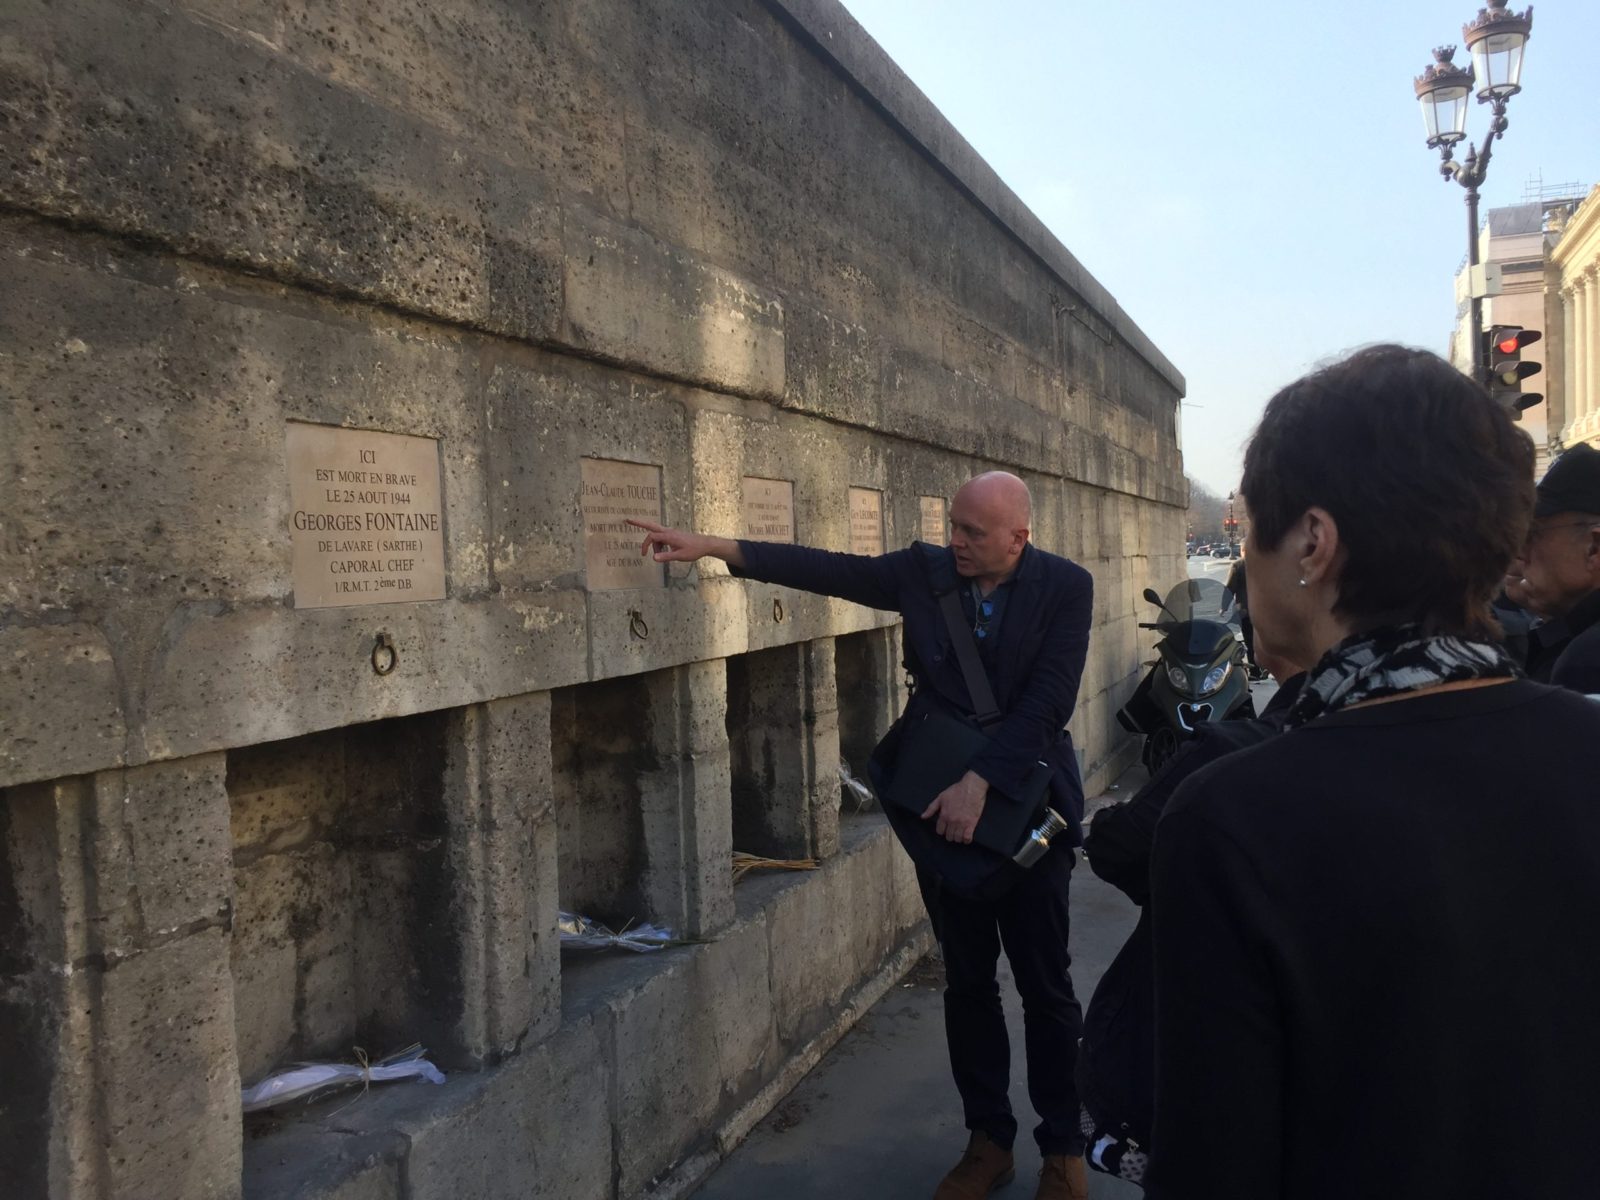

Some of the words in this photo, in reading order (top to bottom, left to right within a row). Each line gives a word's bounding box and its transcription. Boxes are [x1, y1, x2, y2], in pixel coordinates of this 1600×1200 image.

[359, 450, 376, 464] ICI
[316, 469, 335, 481] EST
[338, 471, 367, 483] MORT
[370, 473, 383, 484] EN
[385, 474, 417, 486] BRAVE
[326, 489, 341, 503] LE
[343, 490, 355, 503] 25
[357, 491, 387, 504] AOUT
[390, 492, 411, 505] 1944
[294, 511, 362, 531] GEORGES
[365, 512, 439, 532] FONTAINE
[318, 540, 333, 552] DE
[330, 559, 385, 574] CAPORAL
[387, 558, 414, 572] CHEF
